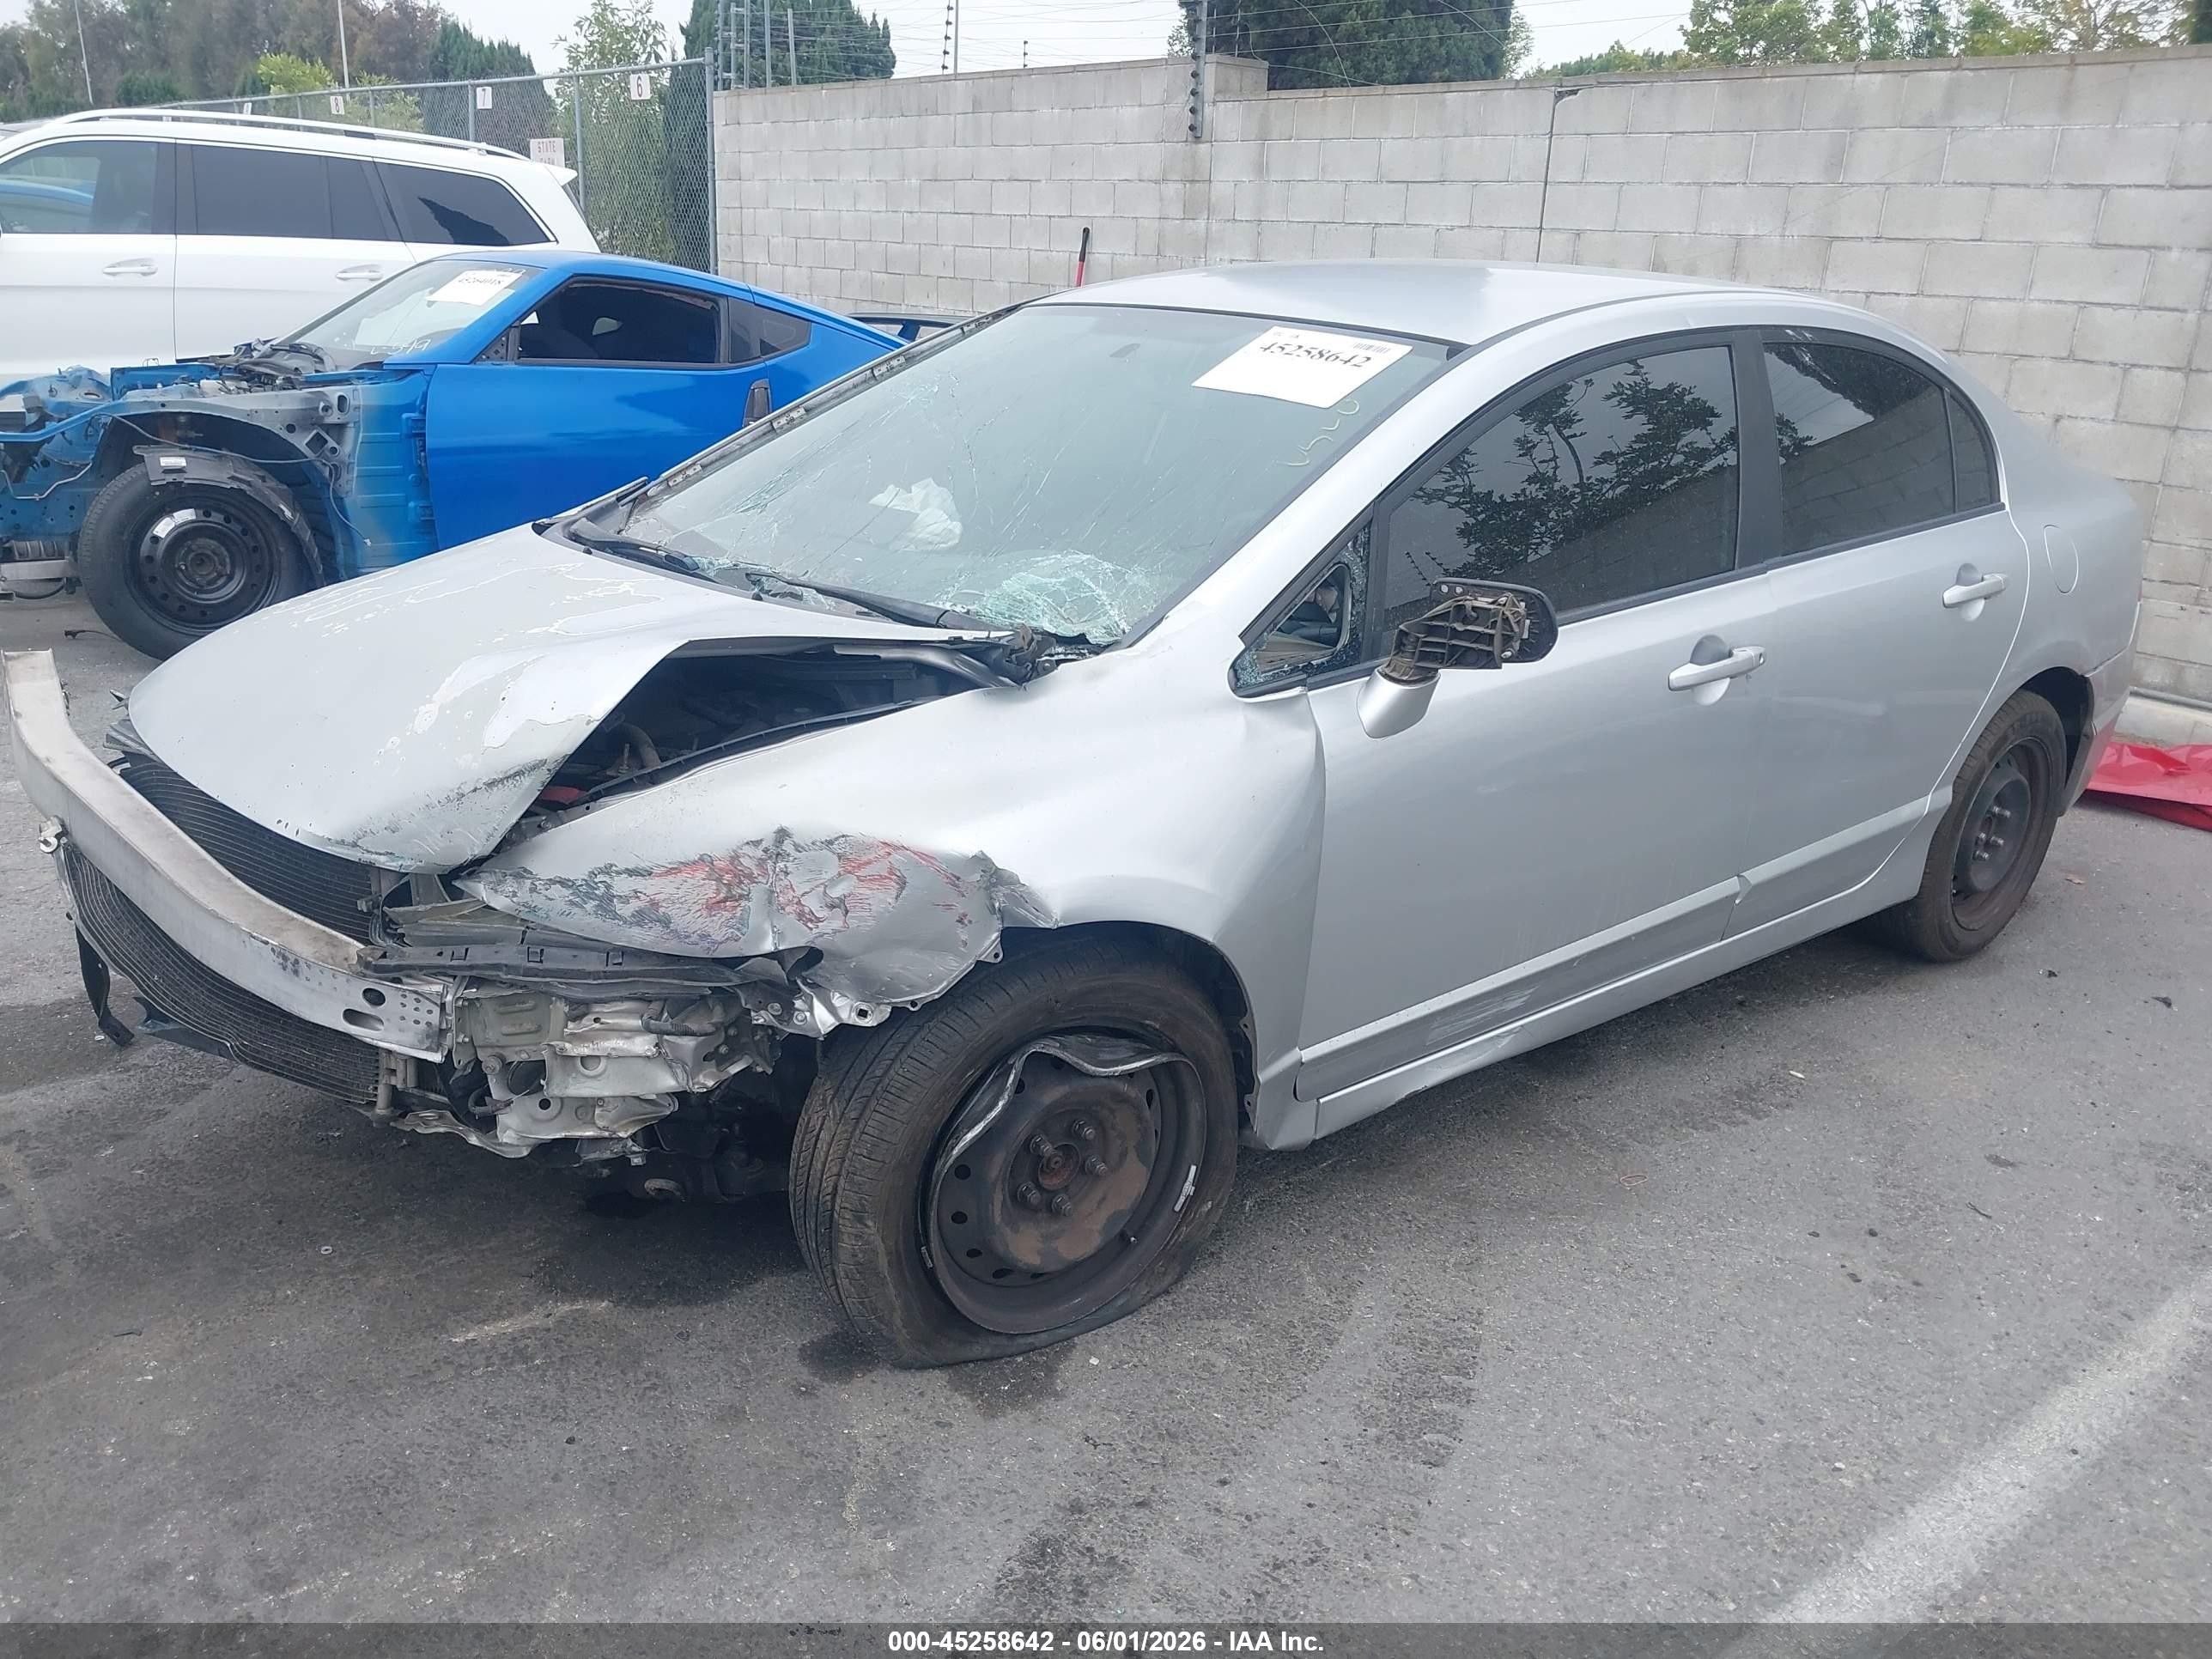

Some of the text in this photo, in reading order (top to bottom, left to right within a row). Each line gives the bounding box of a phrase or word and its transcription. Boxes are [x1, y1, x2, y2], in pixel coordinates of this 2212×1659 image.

[636, 75, 643, 98] 6
[334, 97, 340, 112] 8
[481, 88, 487, 107] 7
[538, 140, 556, 153] STATE
[1259, 342, 1372, 368] 45258642
